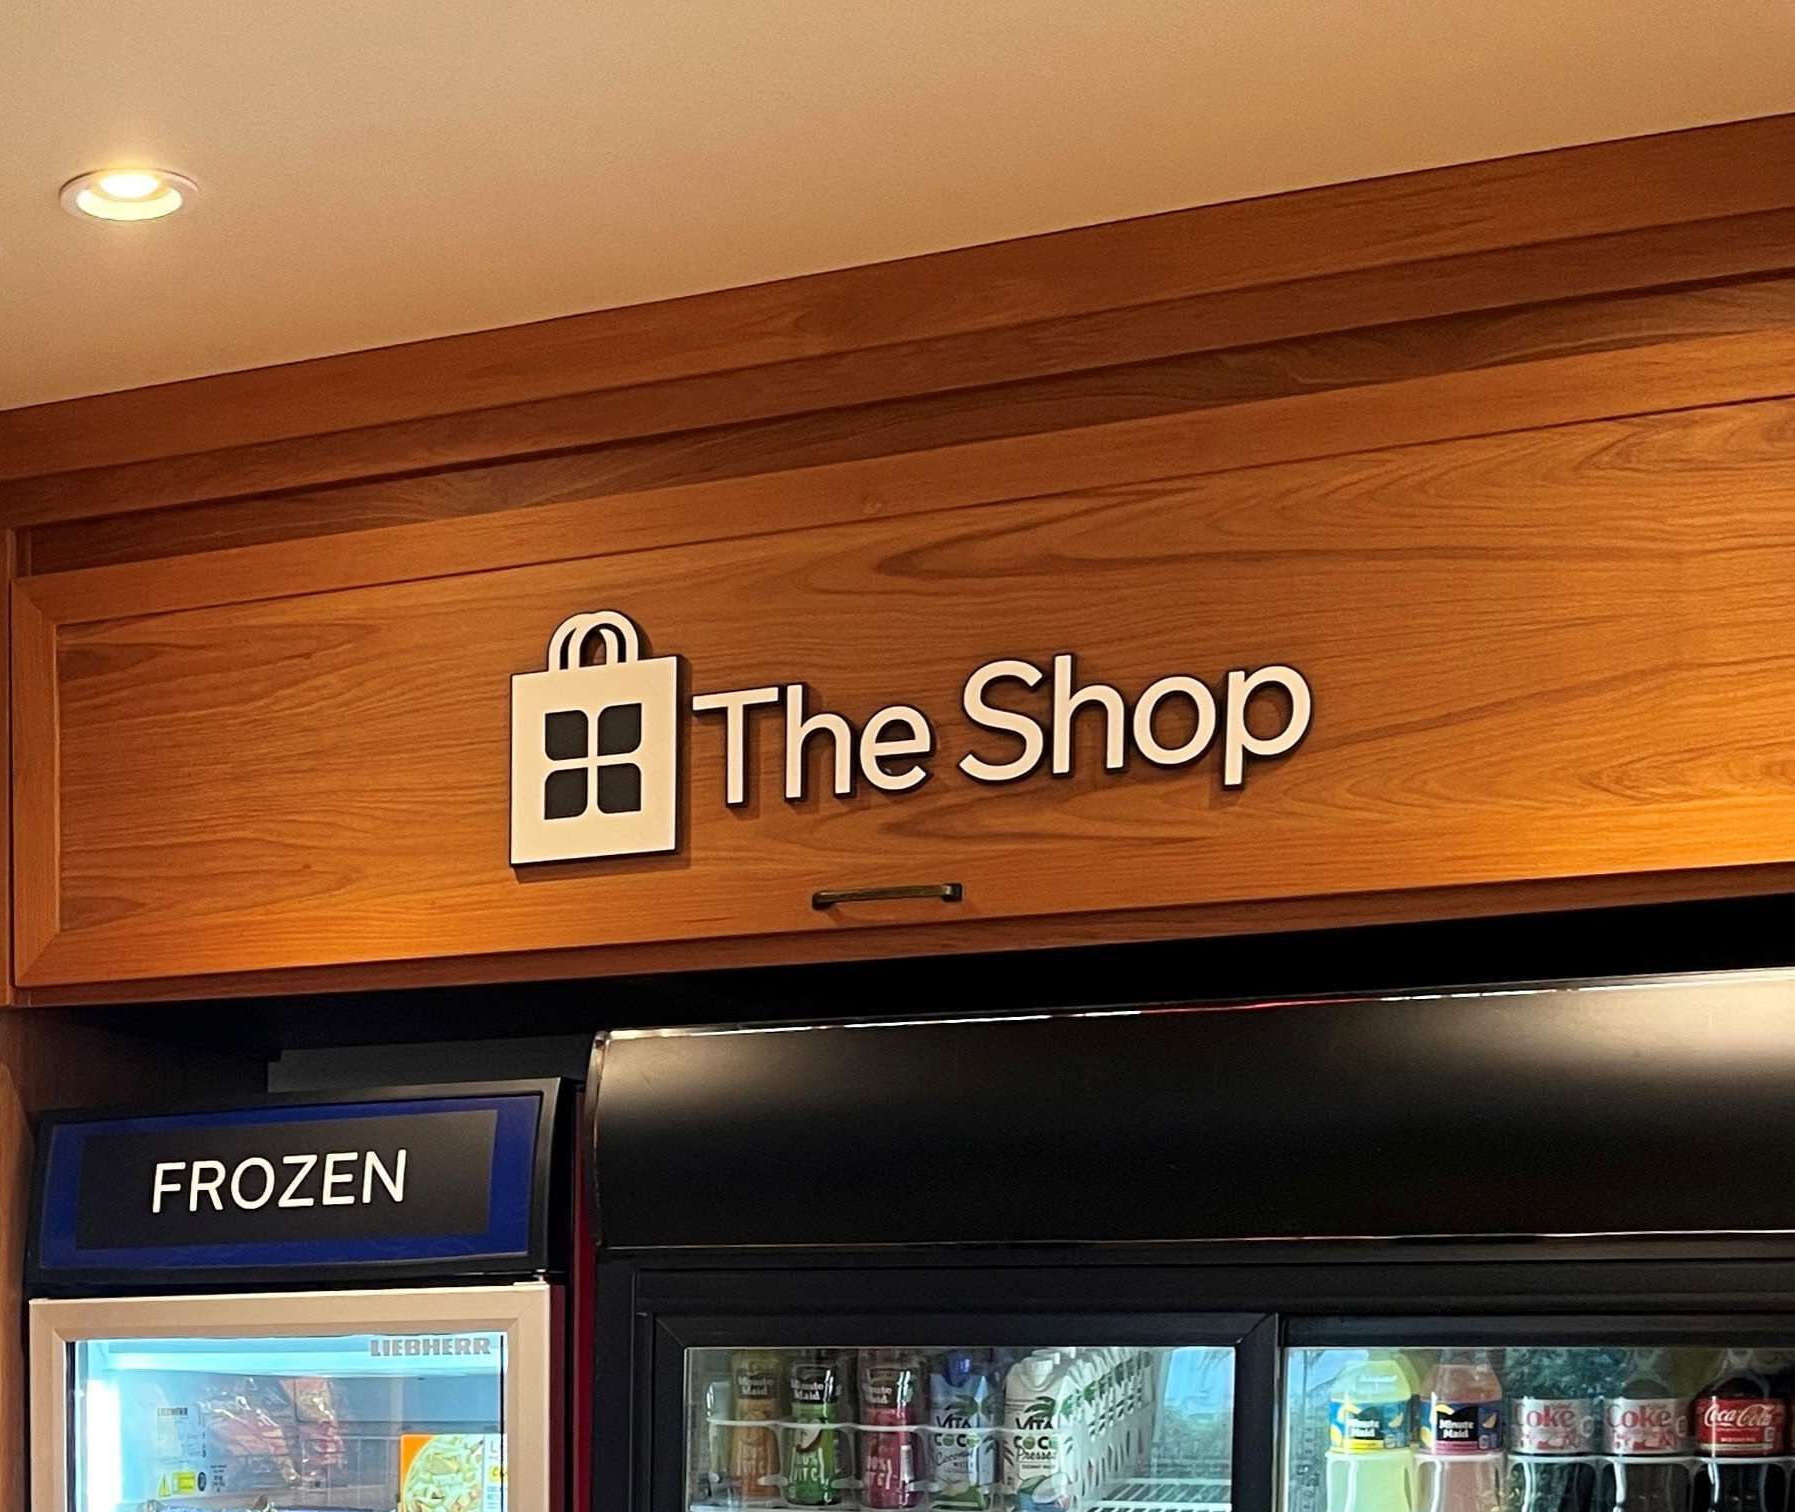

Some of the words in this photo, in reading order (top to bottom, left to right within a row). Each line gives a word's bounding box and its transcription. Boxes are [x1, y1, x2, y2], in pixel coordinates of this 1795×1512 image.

[691, 683, 934, 806] The
[958, 653, 1313, 788] Shop
[152, 1149, 407, 1214] FROZEN
[369, 1338, 492, 1358] LIEBHERR
[791, 1378, 824, 1391] Minute
[794, 1389, 821, 1401] Maid
[936, 1415, 972, 1429] VITA
[1015, 1416, 1054, 1430] VITA
[1514, 1403, 1575, 1429] Coke
[1604, 1403, 1672, 1429] Coke
[1439, 1419, 1474, 1430] Minute
[1349, 1428, 1375, 1438] Maid
[1443, 1428, 1469, 1439] Maid
[934, 1433, 981, 1448] COCO
[1013, 1435, 1059, 1450] COCO
